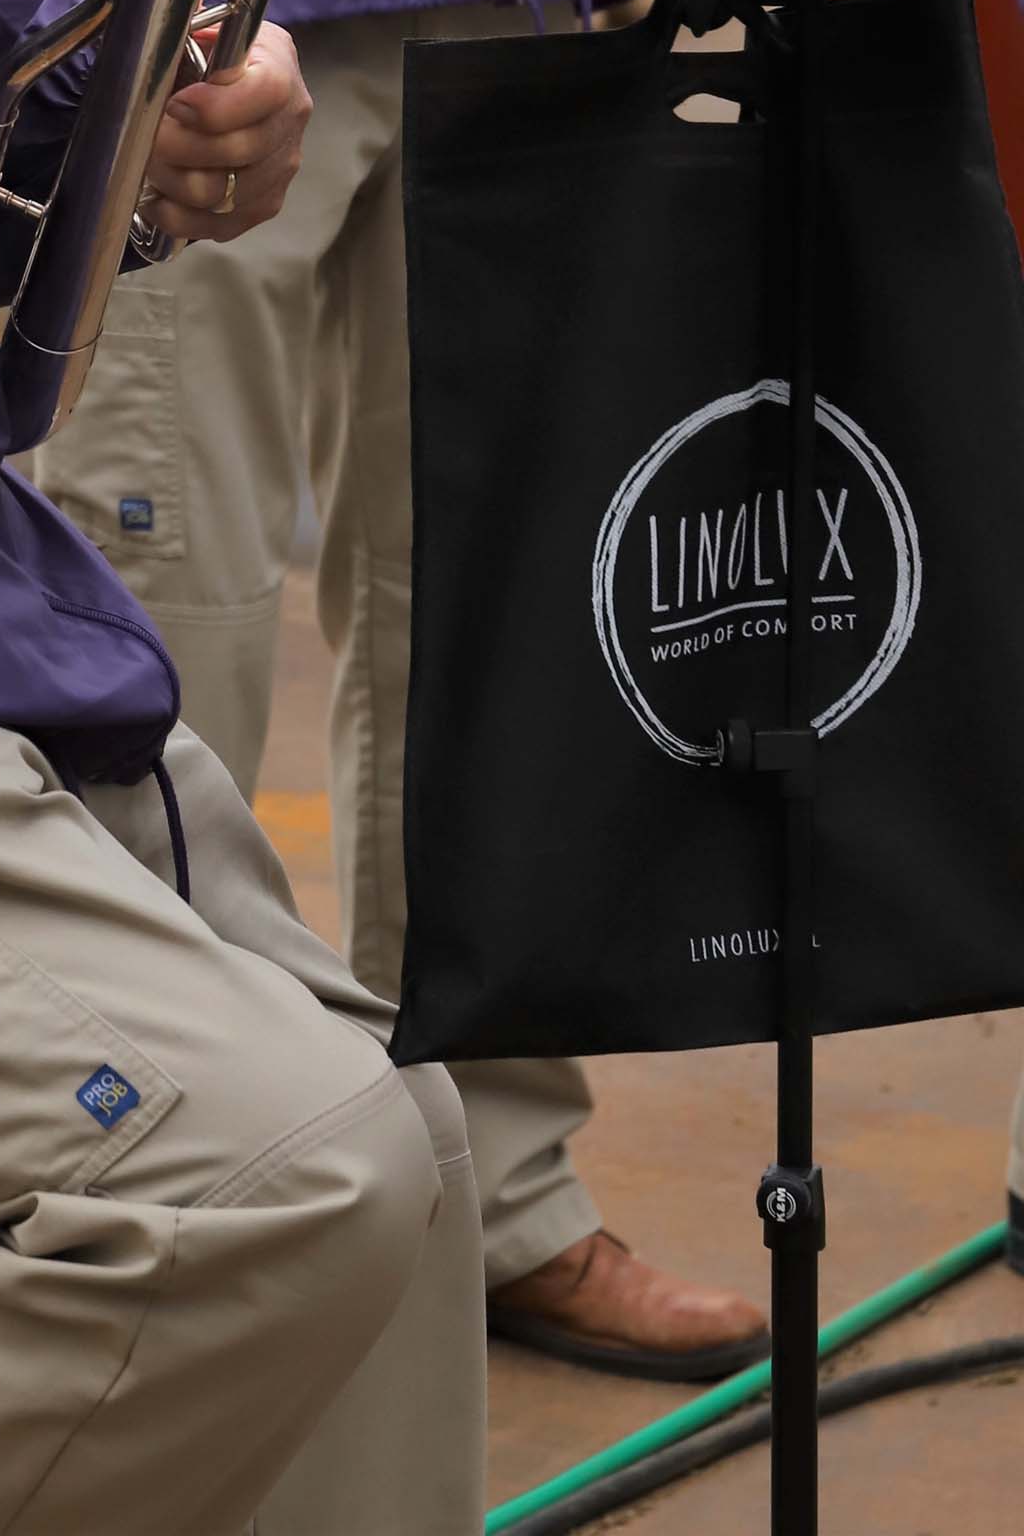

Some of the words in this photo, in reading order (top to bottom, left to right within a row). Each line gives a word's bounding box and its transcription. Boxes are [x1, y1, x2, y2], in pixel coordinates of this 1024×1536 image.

[651, 632, 710, 663] WORLD
[714, 624, 734, 644] OF
[742, 614, 857, 638] COMORT
[83, 1072, 115, 1106] PRO
[96, 1081, 128, 1117] JOB
[776, 1187, 786, 1222] K&M
